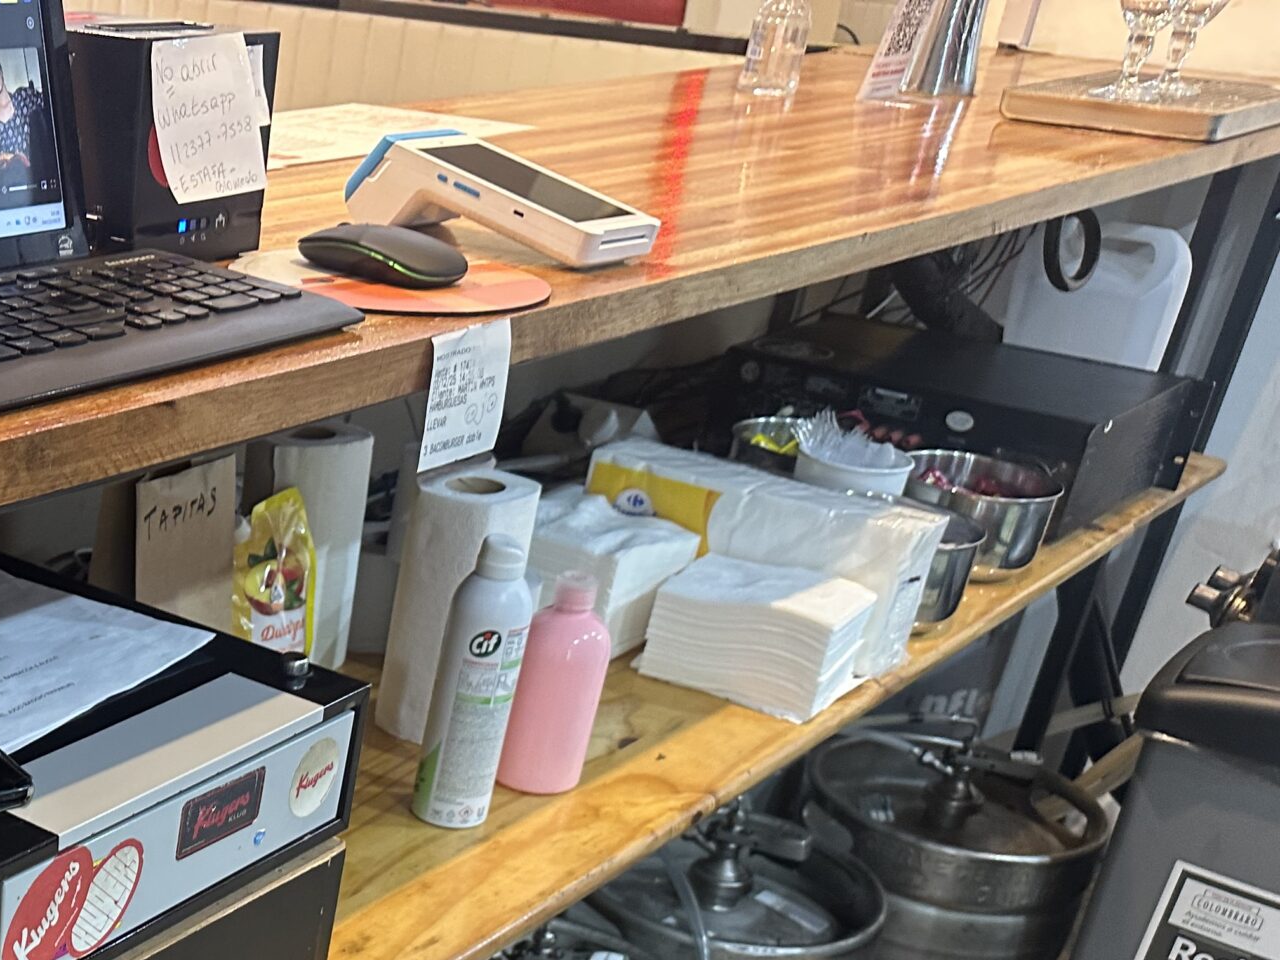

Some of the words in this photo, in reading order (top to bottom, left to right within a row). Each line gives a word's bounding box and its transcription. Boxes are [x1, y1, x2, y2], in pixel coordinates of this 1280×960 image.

[155, 57, 174, 84] No
[180, 53, 217, 81] abrir
[143, 486, 218, 541] TAPITAS
[471, 631, 499, 655] Cif
[295, 761, 334, 799] Klugers
[192, 790, 251, 841] Klugers
